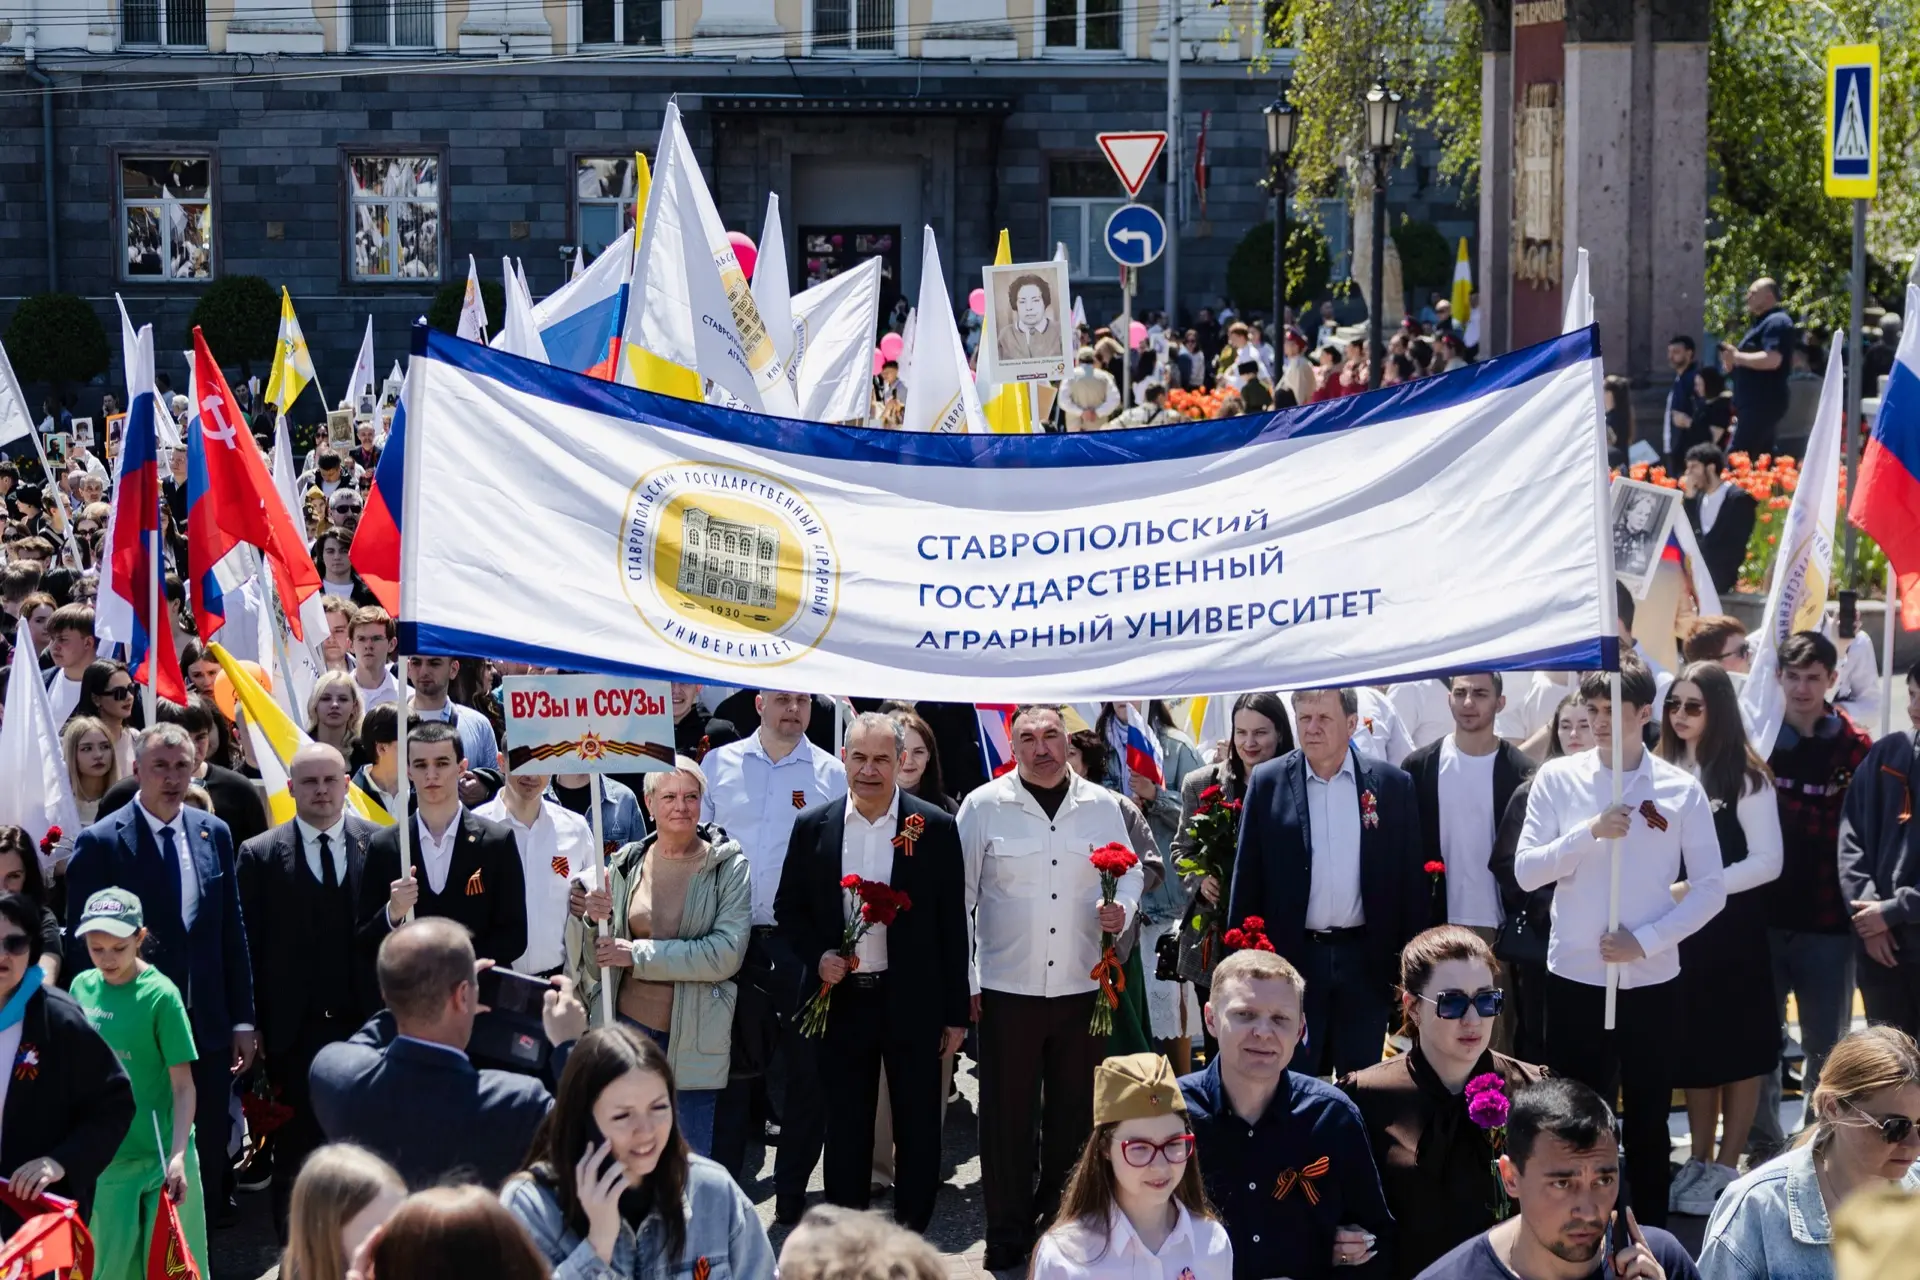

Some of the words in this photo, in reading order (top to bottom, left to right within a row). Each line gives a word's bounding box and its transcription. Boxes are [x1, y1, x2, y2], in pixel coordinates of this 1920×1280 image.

[628, 471, 677, 581] СТАВРОПОЛЬСКИЙ
[685, 471, 820, 537] ГОСУДАРСТВЕННЫЙ
[811, 544, 830, 617] АГРАРНЫЙ
[916, 507, 1269, 562] СТАВРОПОЛЬСКИЙ
[918, 546, 1284, 611] ГОСУДАРСТВЕННЫЙ
[710, 605, 740, 618] 1930
[915, 614, 1114, 650] АГРАРНЫЙ
[1124, 587, 1382, 640] УНИВЕРСИТЕТ
[663, 618, 792, 658] УНИВЕРСИТЕТ
[511, 691, 569, 719] ВУЗы
[593, 688, 665, 716] ССУЗы
[91, 900, 121, 912] SUPER
